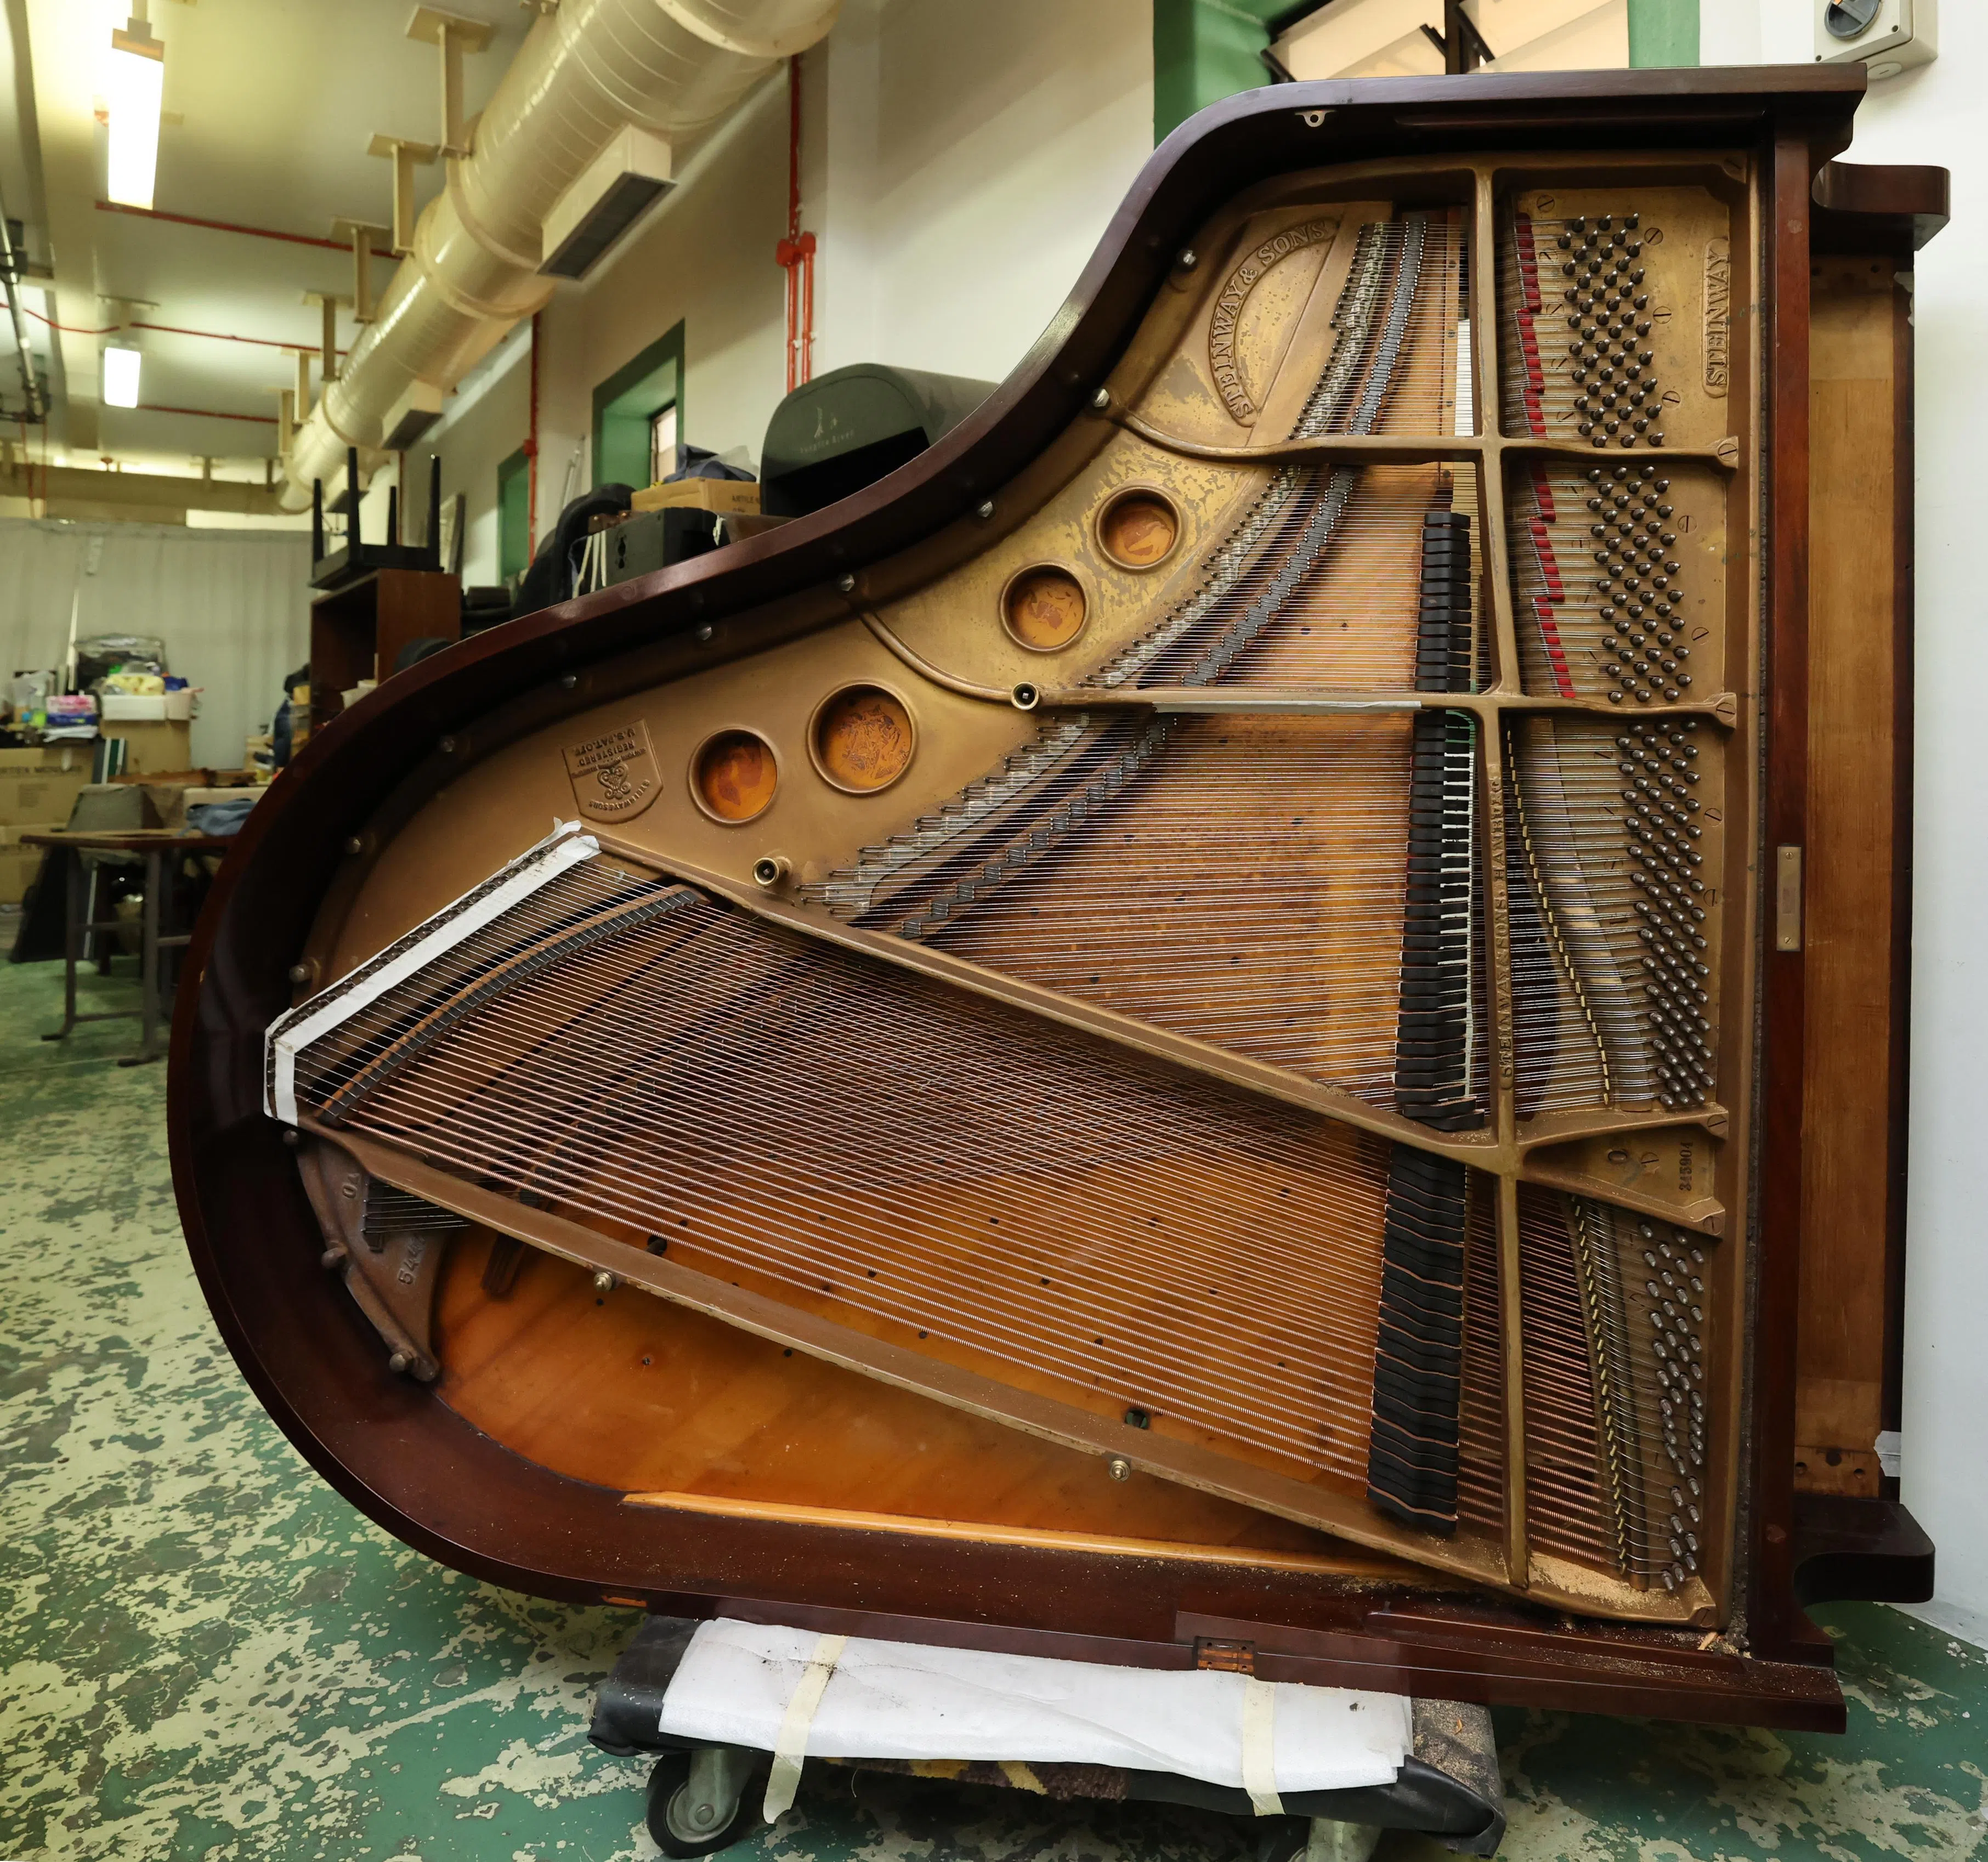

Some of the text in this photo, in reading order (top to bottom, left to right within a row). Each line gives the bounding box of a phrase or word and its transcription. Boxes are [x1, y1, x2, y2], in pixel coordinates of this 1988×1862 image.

[1210, 220, 1327, 418] STEINWAY & SONS
[1706, 248, 1729, 387] STEINWAY
